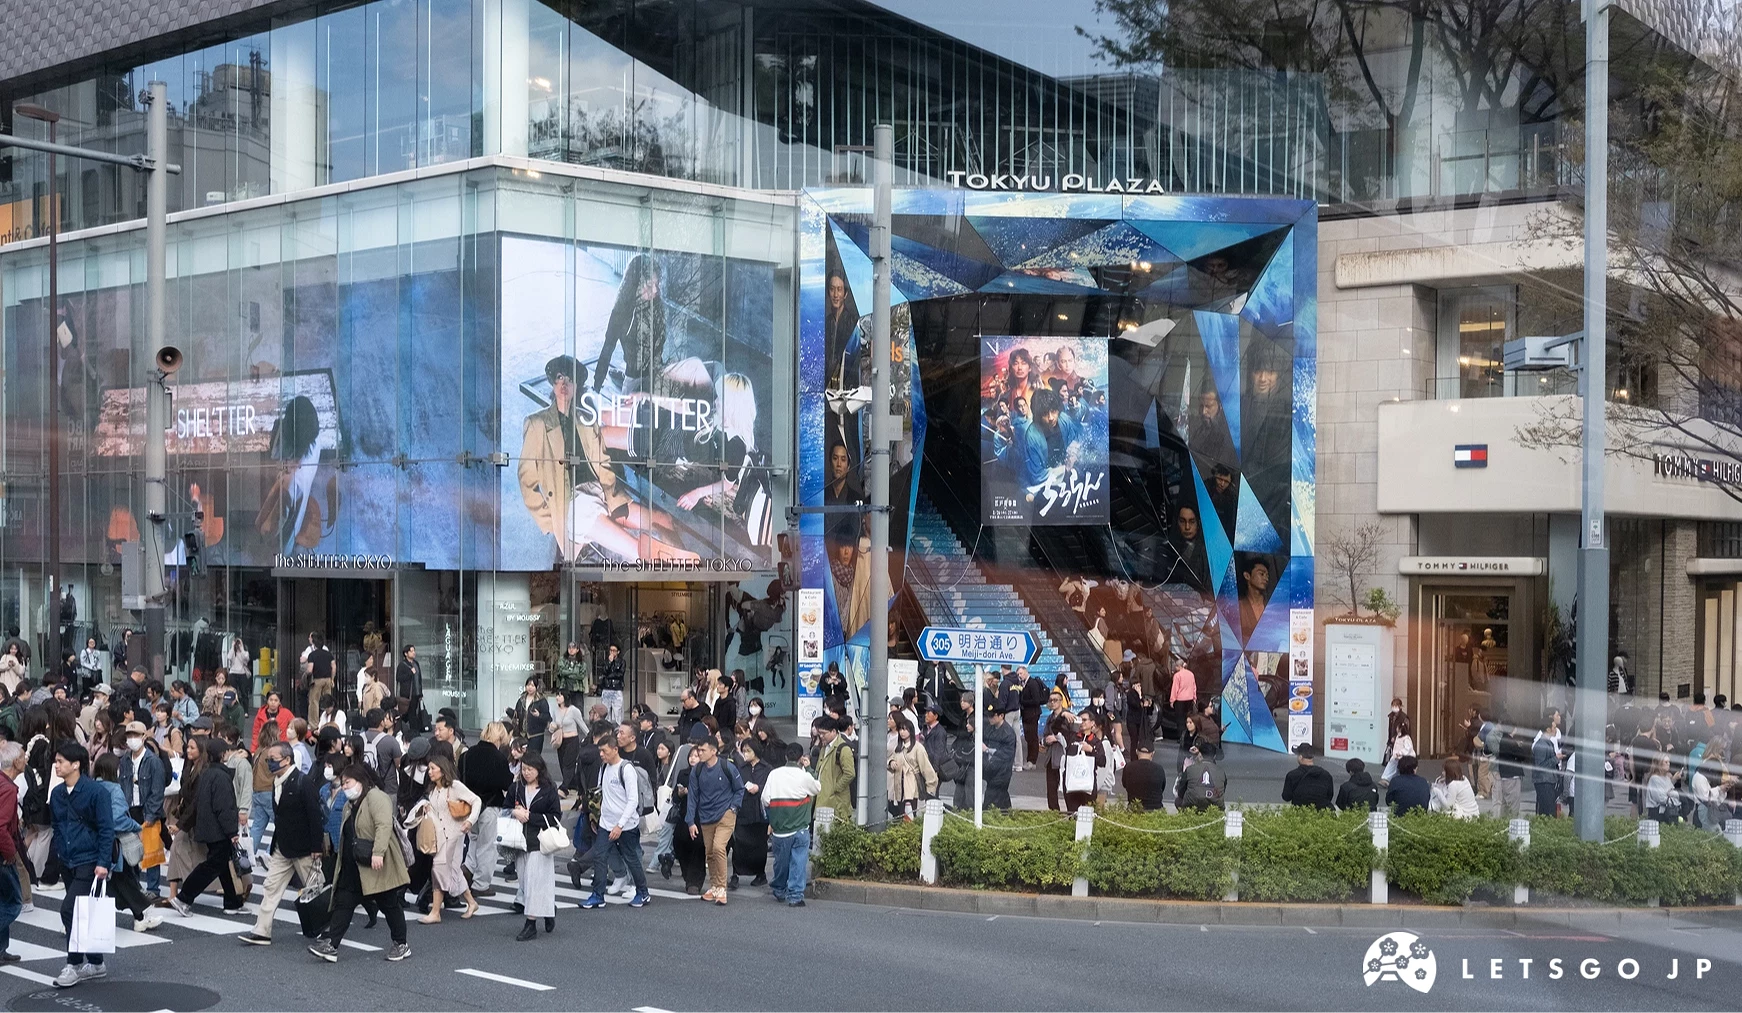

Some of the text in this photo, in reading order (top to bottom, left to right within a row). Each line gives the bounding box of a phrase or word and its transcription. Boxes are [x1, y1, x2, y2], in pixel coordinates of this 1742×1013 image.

[948, 170, 1165, 194] TOKYU PLAZA
[25, 223, 50, 240] Cfe
[1656, 453, 1699, 478] TOMMY
[273, 553, 294, 568] The
[351, 554, 392, 570] TOKYO
[602, 557, 630, 572] The
[705, 558, 753, 572] TOKYO
[1470, 562, 1509, 571] HILFIGER
[933, 637, 951, 651] 305
[958, 633, 1018, 651] 明治通り
[961, 649, 1016, 660] Meiji-dori Ave.
[491, 663, 535, 672] STYLEMIXER
